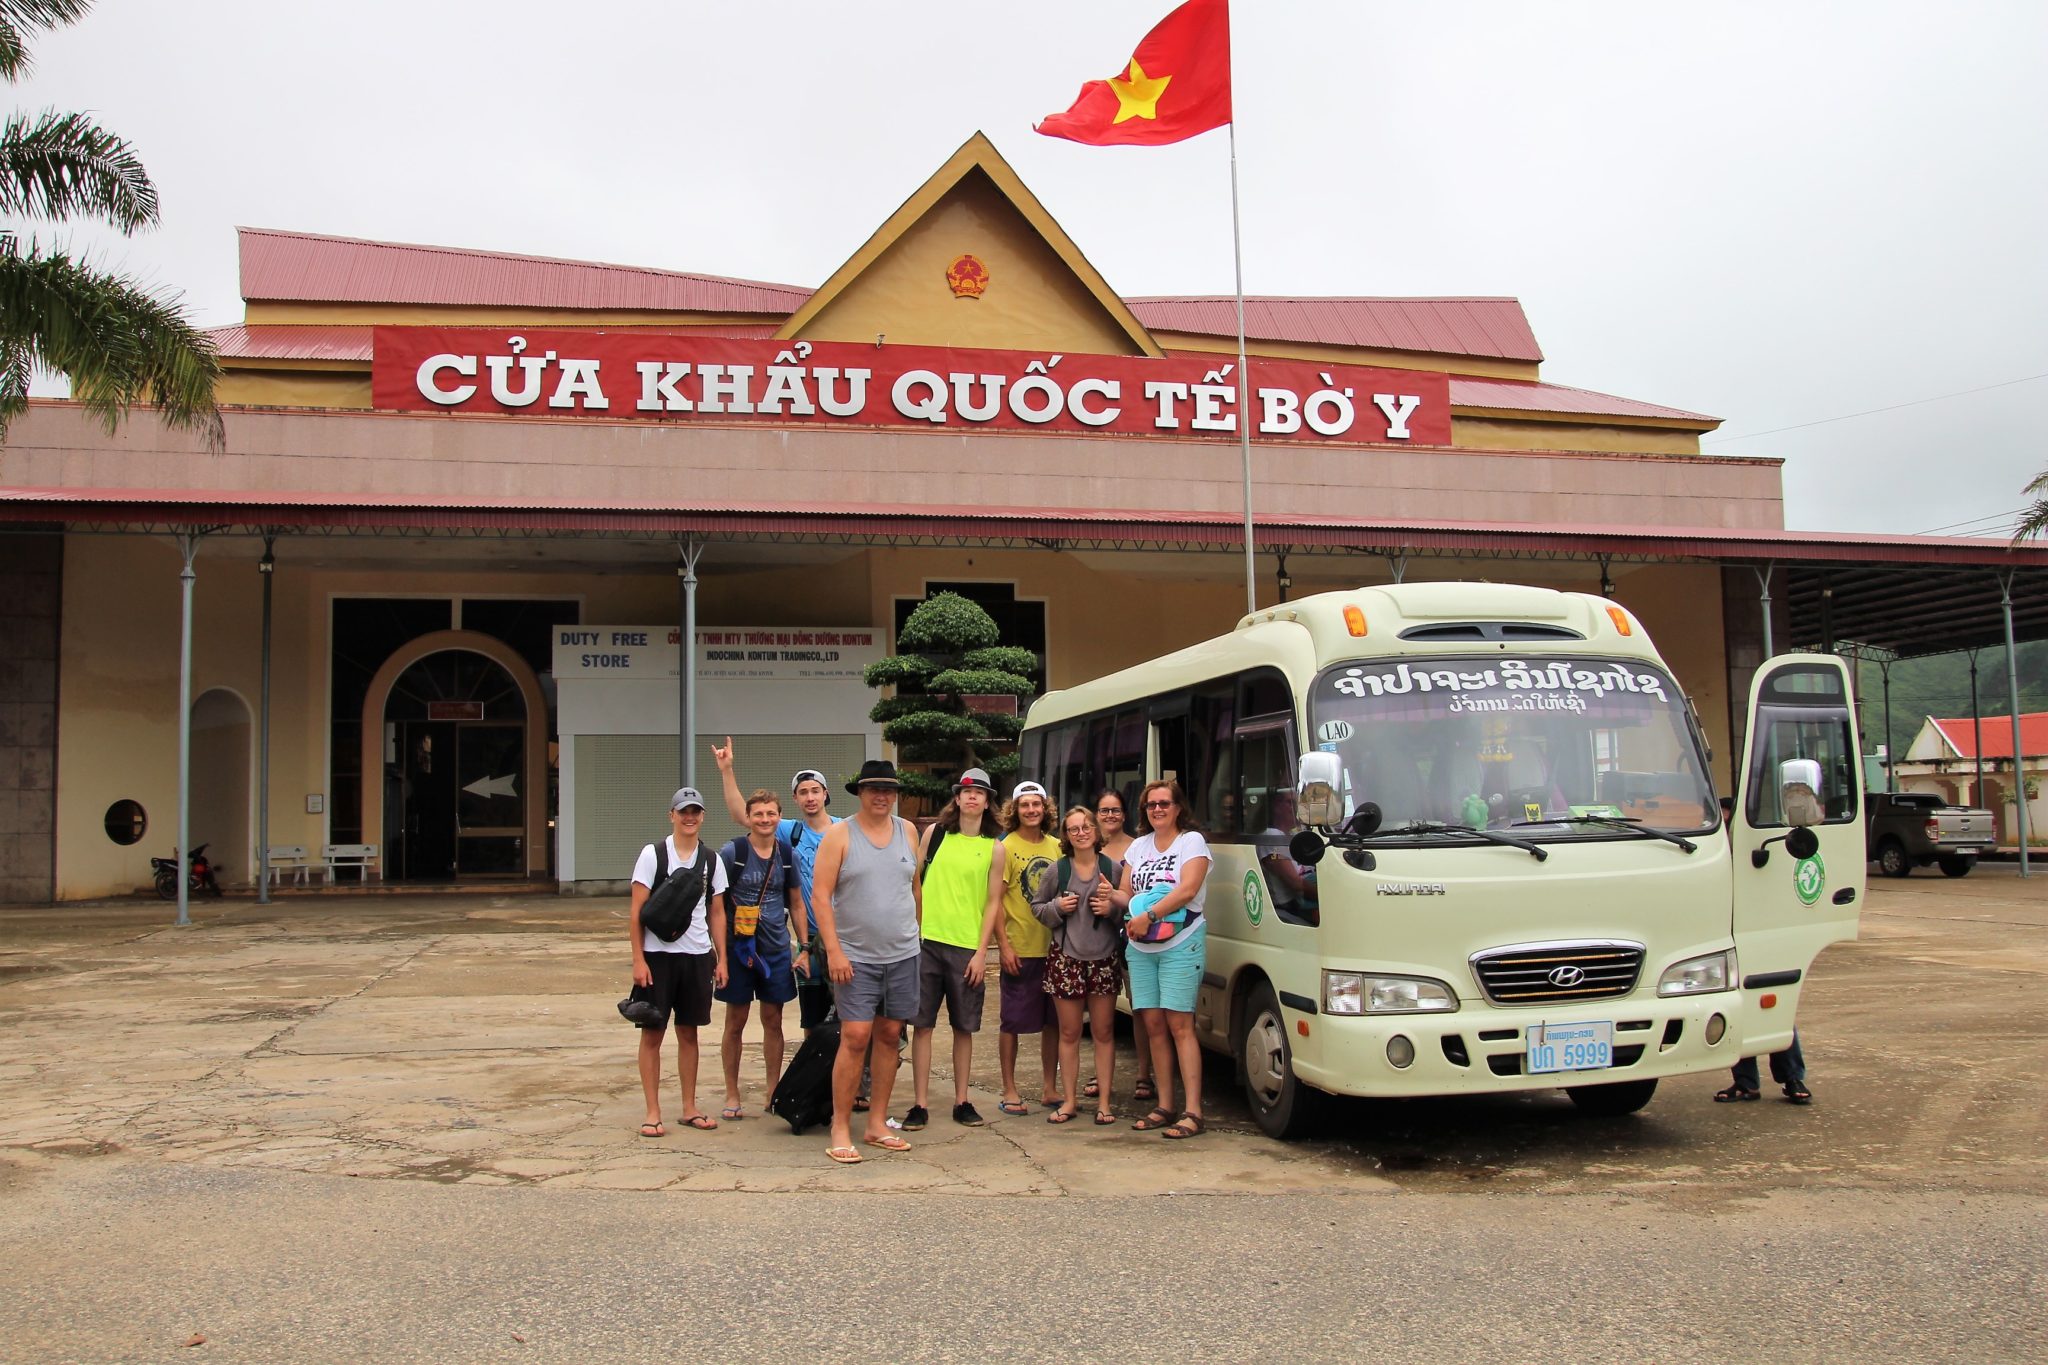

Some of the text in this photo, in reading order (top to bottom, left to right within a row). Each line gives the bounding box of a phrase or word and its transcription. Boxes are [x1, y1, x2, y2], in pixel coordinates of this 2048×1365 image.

[416, 336, 1420, 439] CỬA KHẨU QUỐC TẾ BỜ Y
[561, 632, 648, 646] DUTY FREE
[842, 633, 873, 646] KONTUM
[581, 654, 630, 668] STORE
[706, 650, 745, 661] INDOCHINA
[747, 651, 778, 661] KONTUM
[1325, 721, 1349, 740] LAO
[1564, 1041, 1608, 1067] 5999
